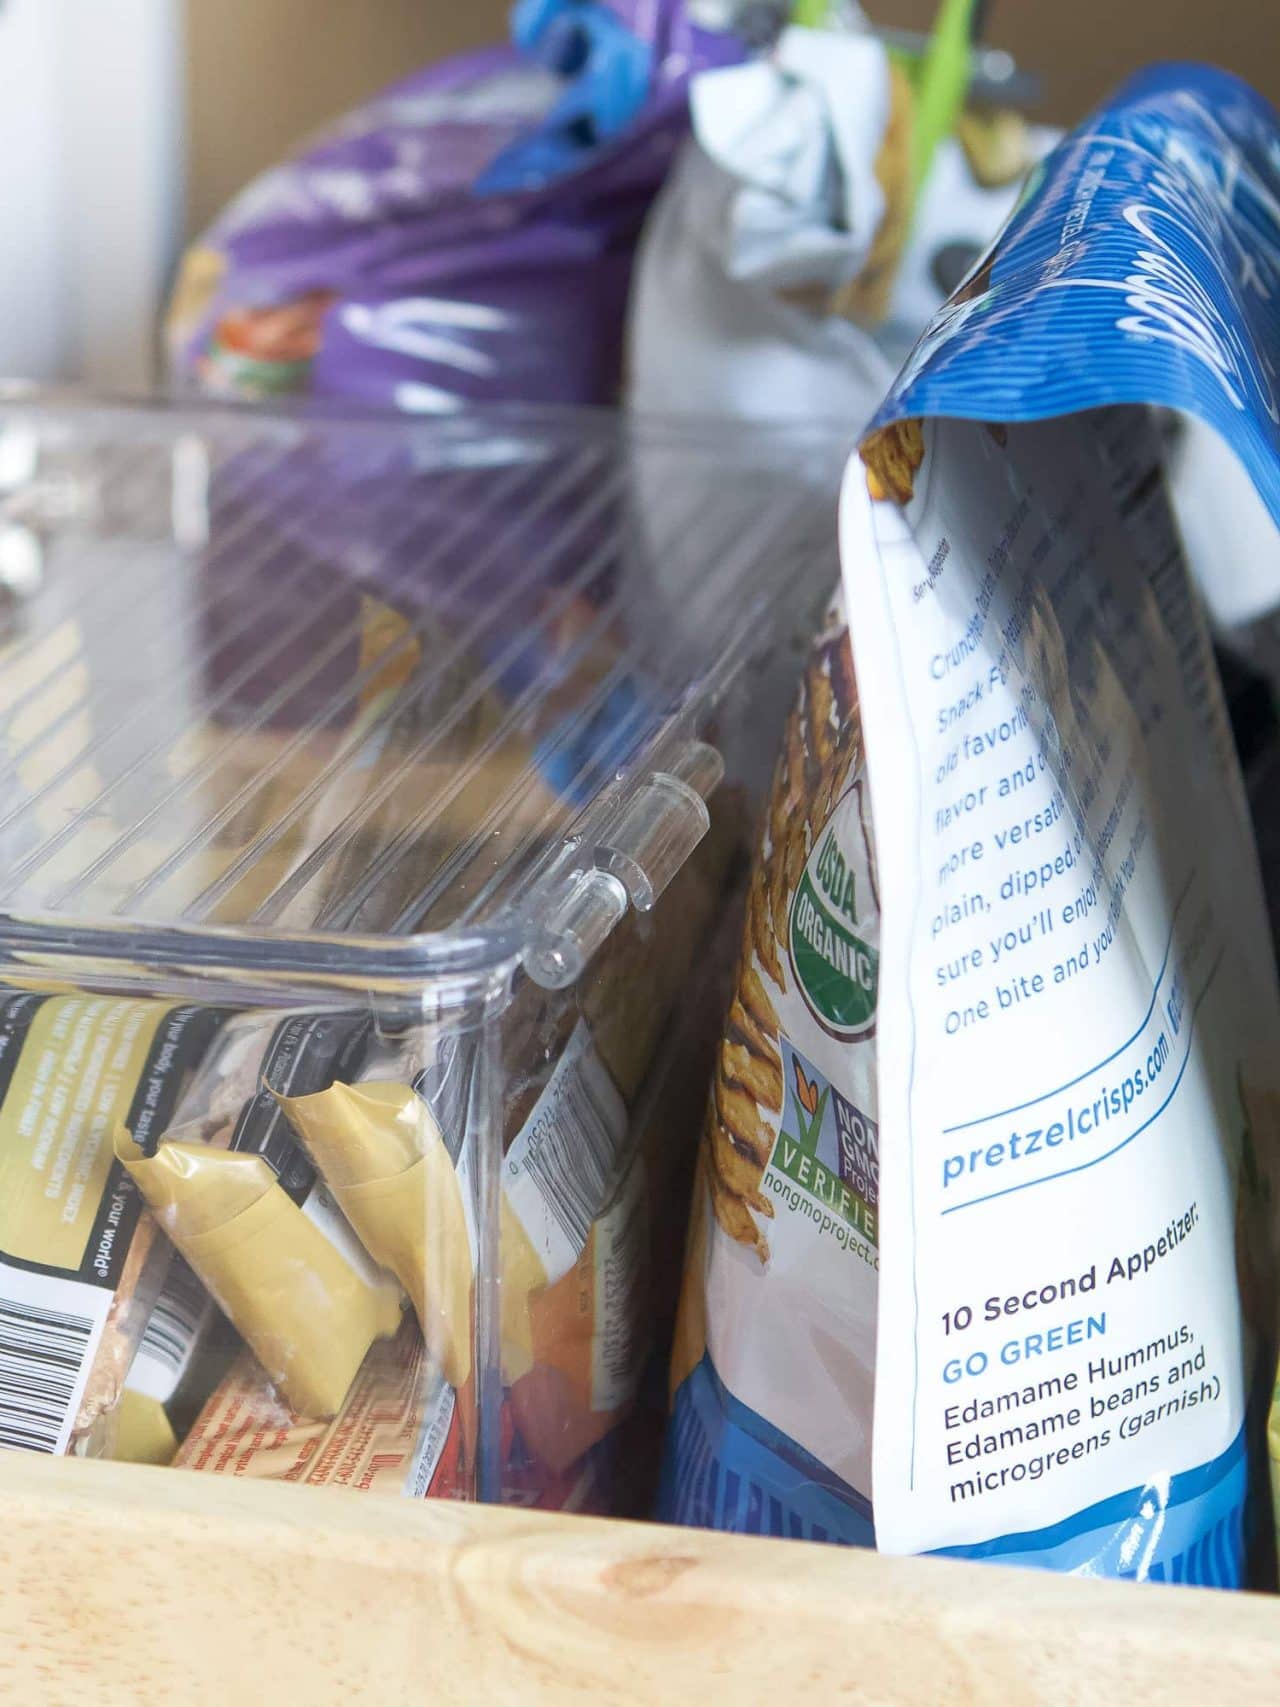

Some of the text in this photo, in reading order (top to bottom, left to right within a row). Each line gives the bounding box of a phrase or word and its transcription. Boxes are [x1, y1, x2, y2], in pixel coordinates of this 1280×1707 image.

[998, 756, 1036, 798] and
[815, 825, 858, 927] USDA
[931, 893, 992, 943] plain,
[1000, 843, 1078, 901] dipped,
[796, 892, 873, 991] ORGANIC
[936, 948, 984, 987] sure
[1062, 884, 1098, 926] enjoy
[944, 999, 990, 1036] One
[996, 973, 1045, 1010] bite
[1053, 943, 1090, 985] and
[145, 1077, 164, 1108] your
[837, 1100, 879, 1161] NON
[941, 1030, 1170, 1187] pretzelcrisps.com
[107, 1193, 127, 1227] your
[783, 1140, 875, 1239] VERIFIE
[941, 1201, 1199, 1336] 10 Second Appetizer:
[942, 1311, 1107, 1385] GO GREEN
[944, 1324, 1195, 1430] Edamame Hummus,
[946, 1345, 1207, 1466] Edamame beans and
[949, 1375, 1221, 1503] microgreens (garnish)
